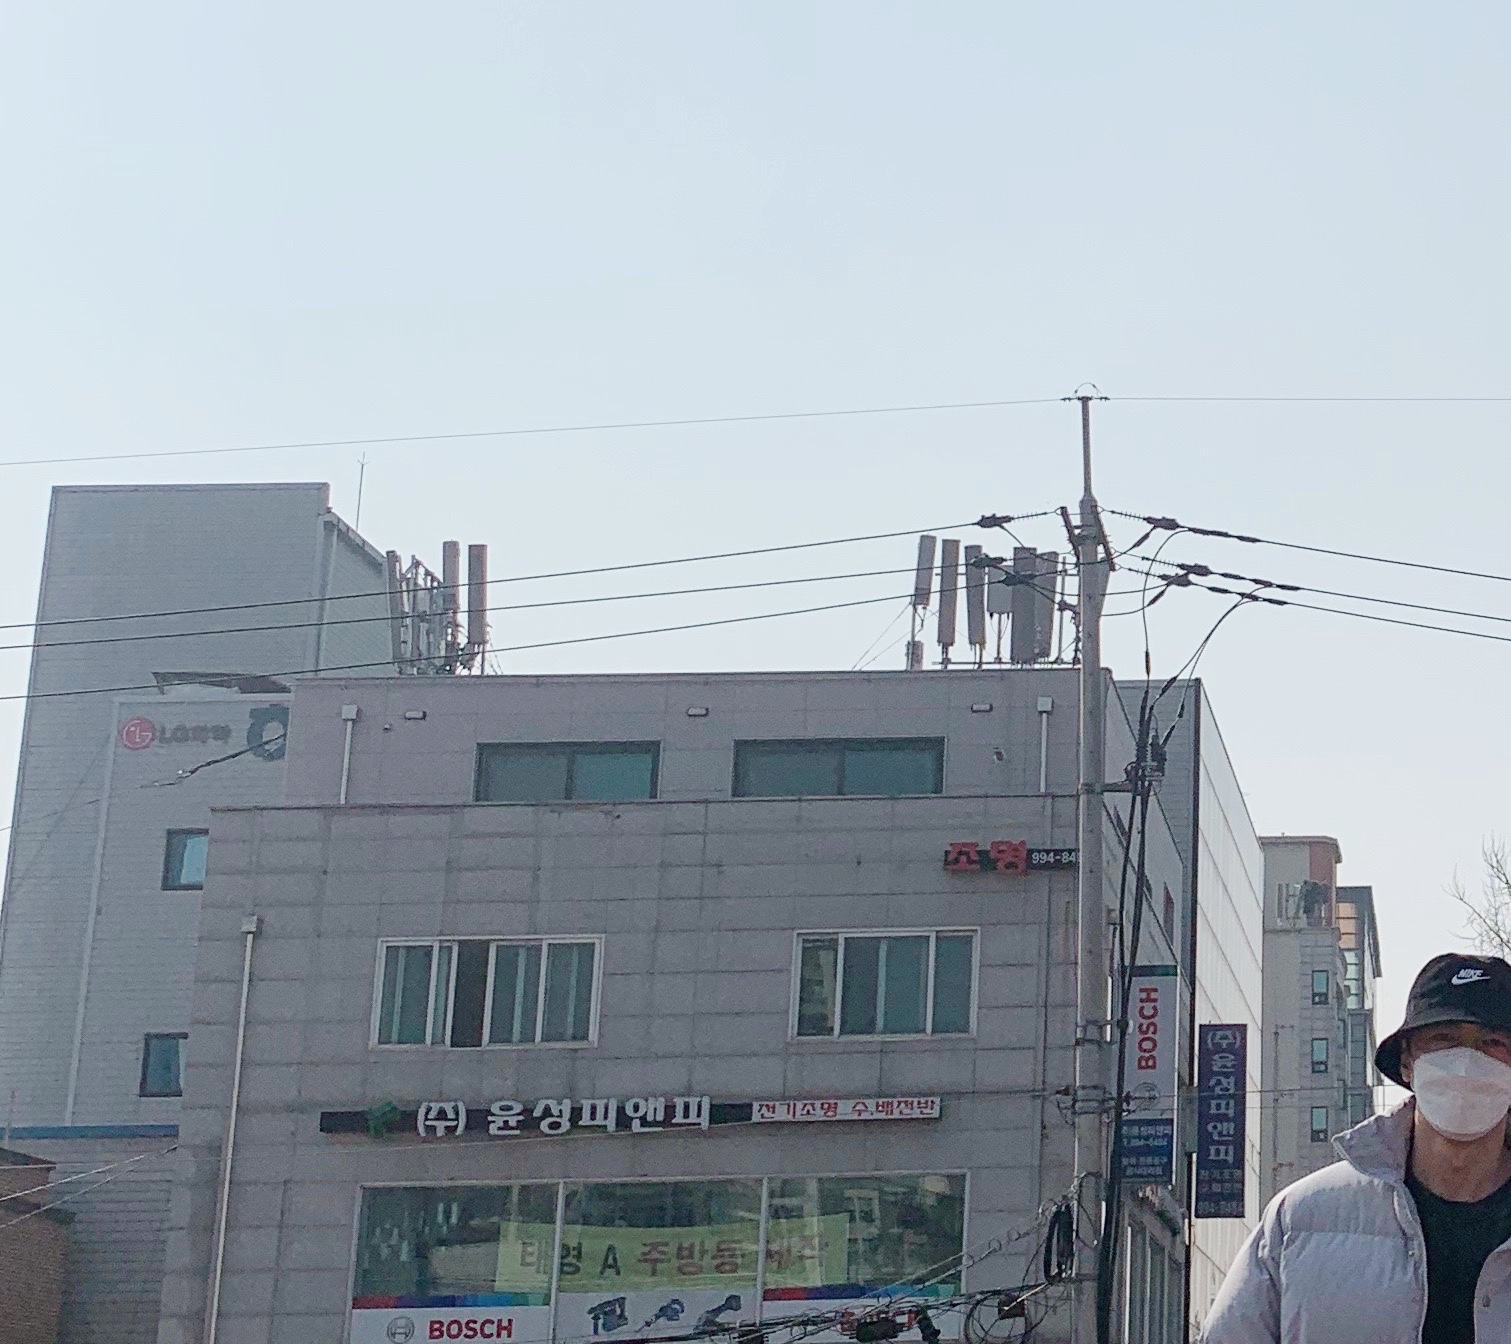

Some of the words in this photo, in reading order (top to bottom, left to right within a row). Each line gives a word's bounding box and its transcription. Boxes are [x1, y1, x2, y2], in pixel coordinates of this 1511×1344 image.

[948, 840, 1028, 876] 조명
[1031, 852, 1080, 864] 994-84
[1458, 968, 1484, 978] NIKE
[1137, 987, 1159, 1071] BOSCH
[417, 1100, 467, 1137] (주)
[487, 1095, 711, 1136] 윤성피앤피
[758, 1101, 839, 1120] 전기조명
[601, 1244, 621, 1276] A
[428, 1318, 514, 1340] BOSCH
